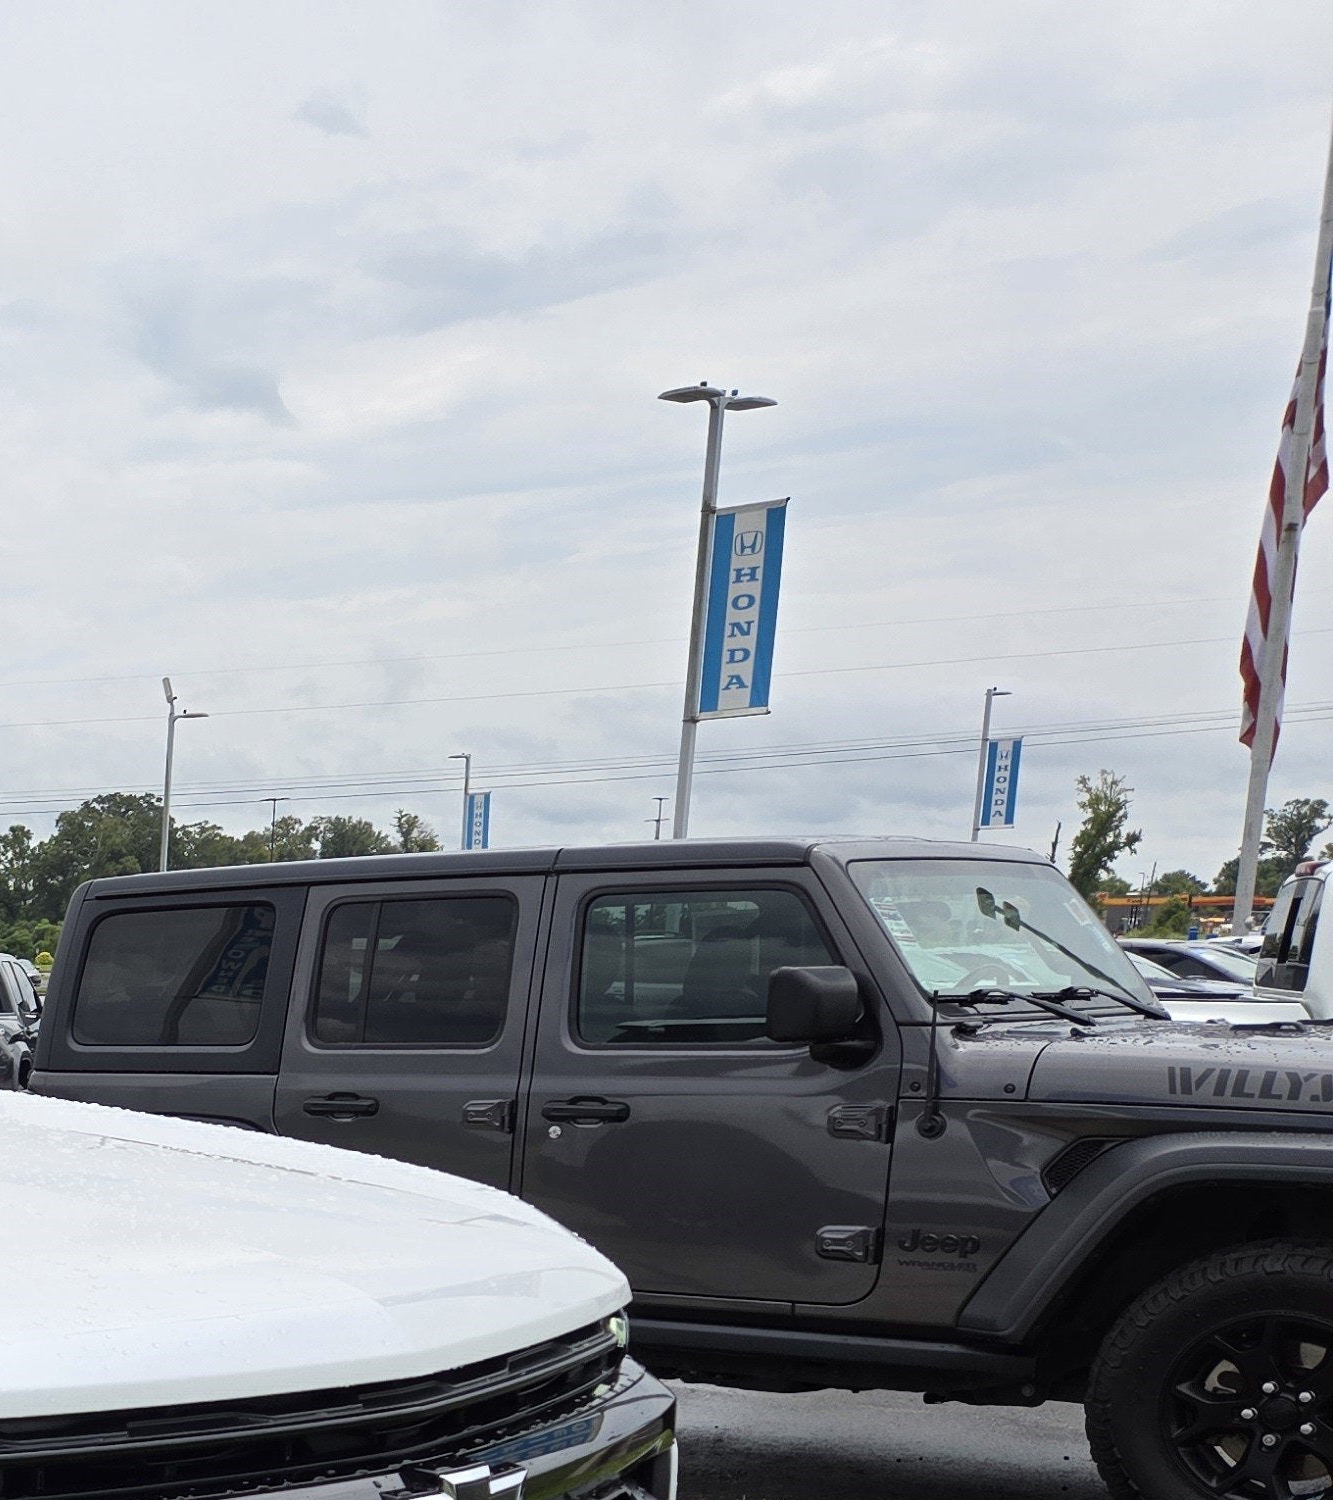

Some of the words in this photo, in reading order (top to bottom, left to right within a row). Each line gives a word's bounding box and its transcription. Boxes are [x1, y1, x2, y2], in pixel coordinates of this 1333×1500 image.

[721, 565, 761, 692] HONDA
[991, 764, 1009, 818] HONDA
[474, 812, 483, 846] HOND
[897, 1229, 980, 1259] Jeep
